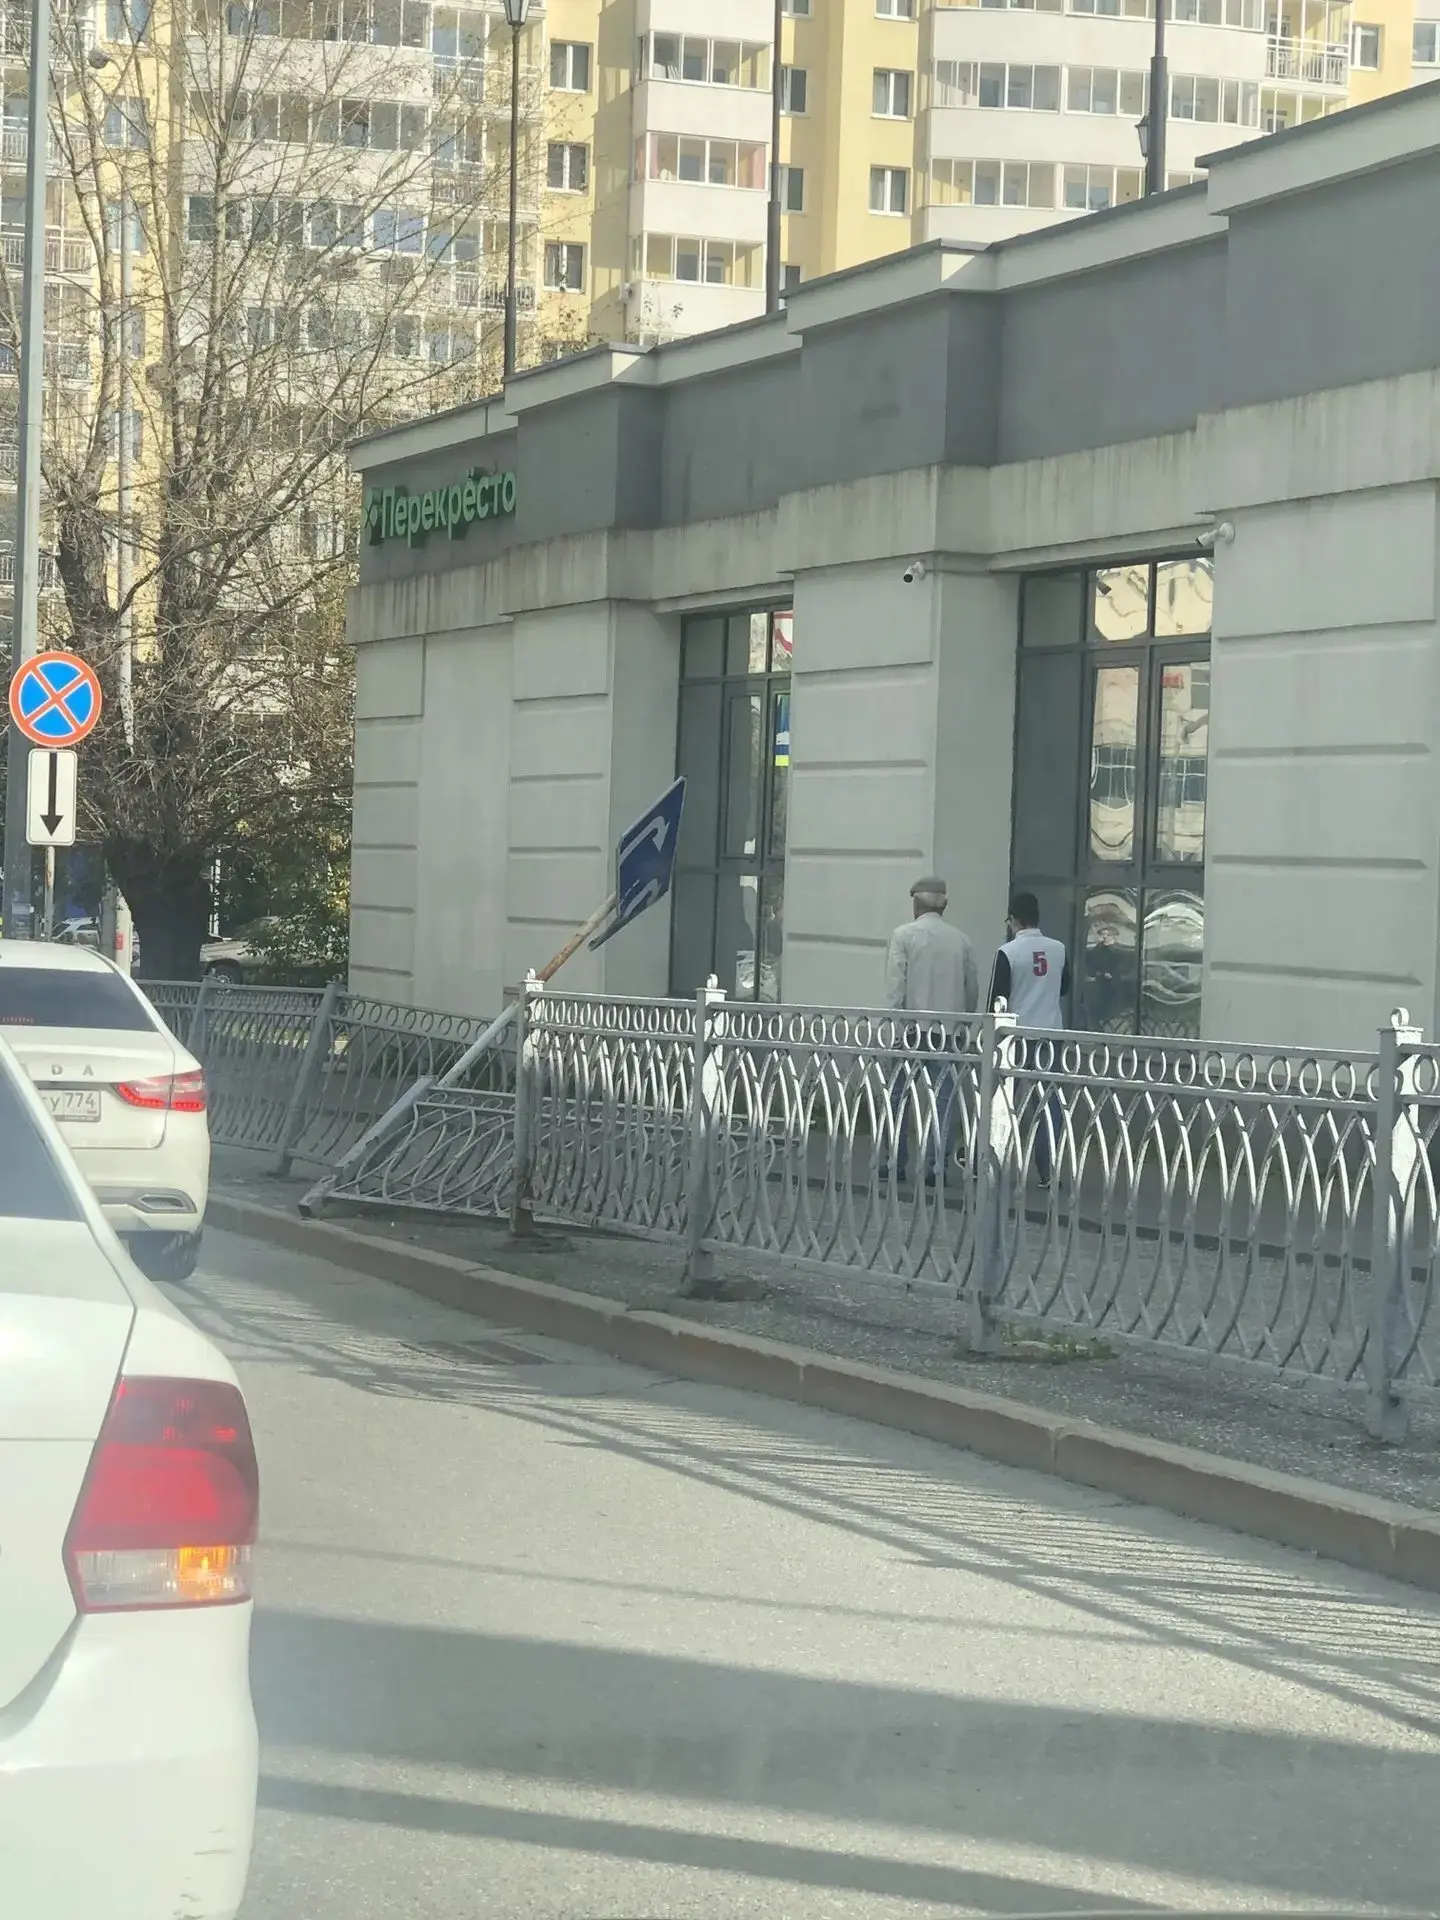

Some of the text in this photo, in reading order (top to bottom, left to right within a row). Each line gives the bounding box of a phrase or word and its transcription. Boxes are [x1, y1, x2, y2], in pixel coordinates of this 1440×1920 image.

[381, 467, 517, 549] Перекрёсто
[1032, 951, 1048, 977] 5
[64, 1091, 95, 1108] 774
